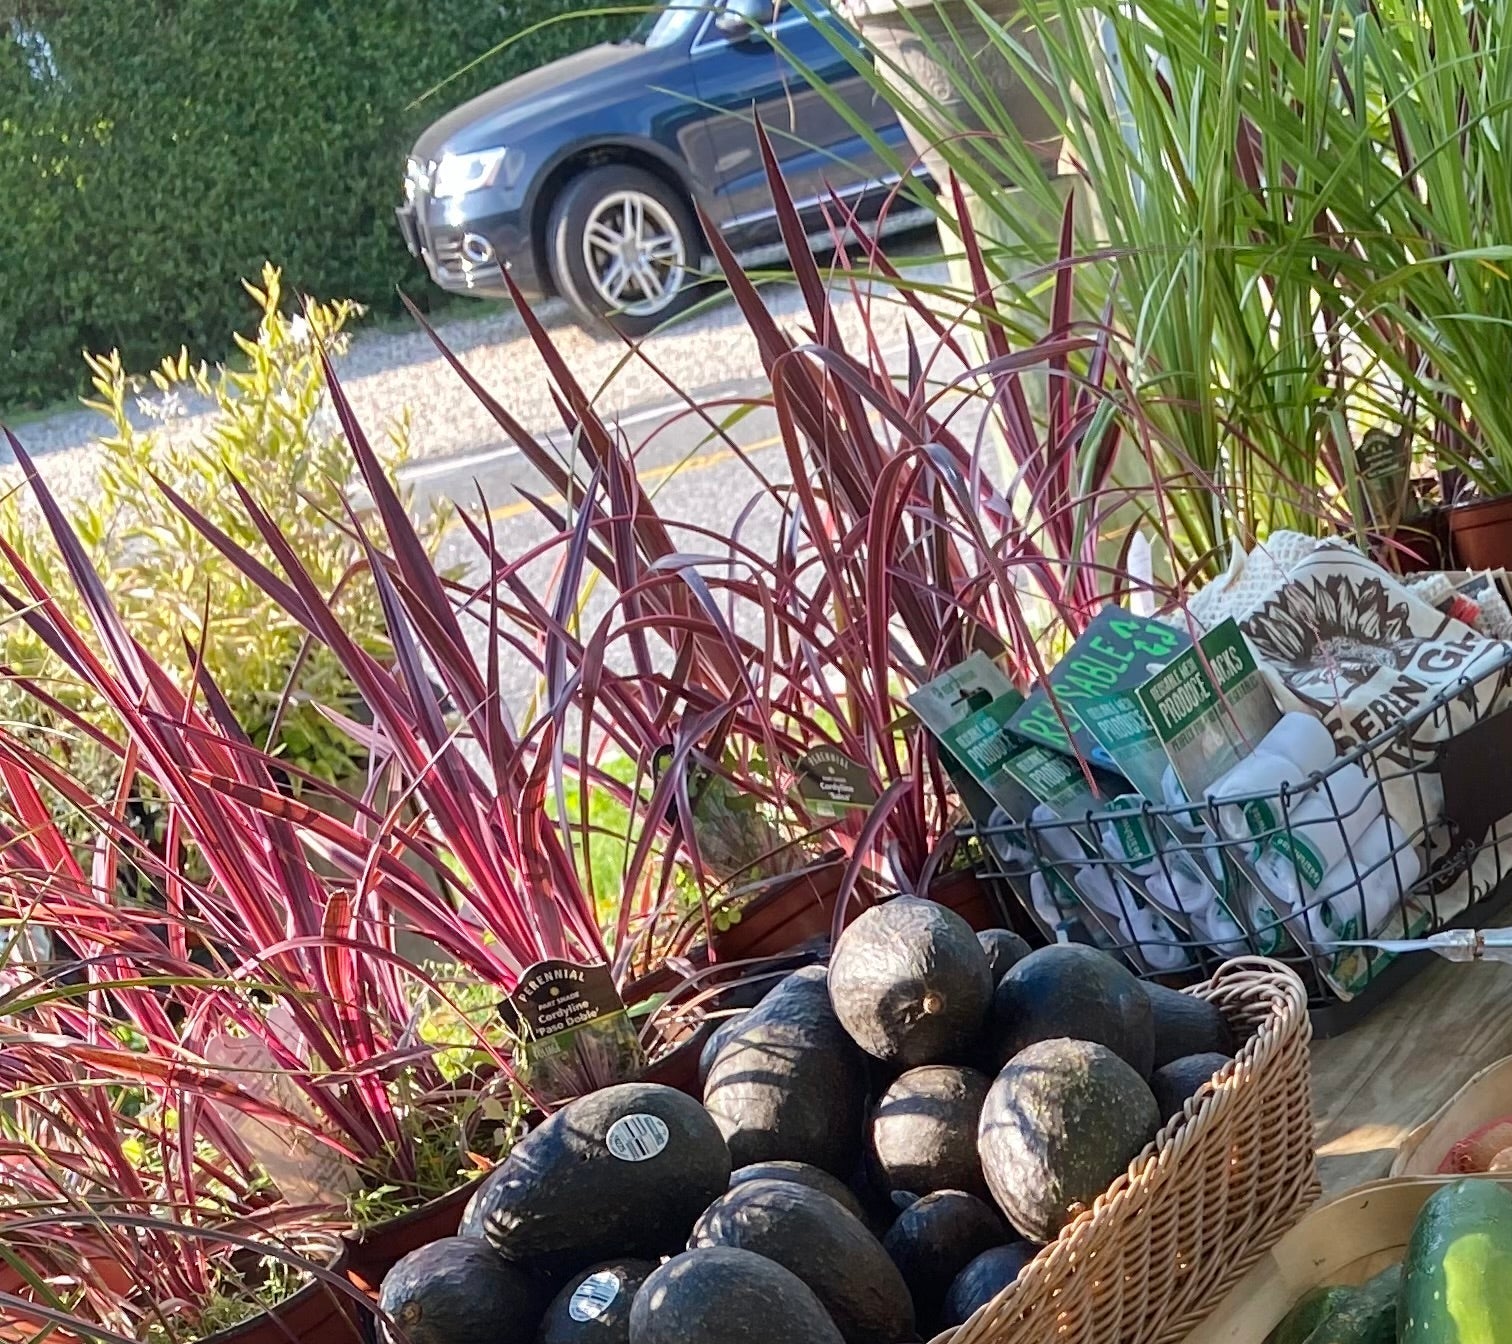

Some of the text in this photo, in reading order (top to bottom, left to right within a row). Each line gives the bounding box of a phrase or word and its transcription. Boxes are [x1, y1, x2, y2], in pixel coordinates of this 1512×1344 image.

[1158, 676, 1211, 728] PRODUCE
[1212, 646, 1245, 689] ACKS
[518, 968, 585, 1003] PERENNIAL
[538, 1000, 590, 1025] Cordyline
